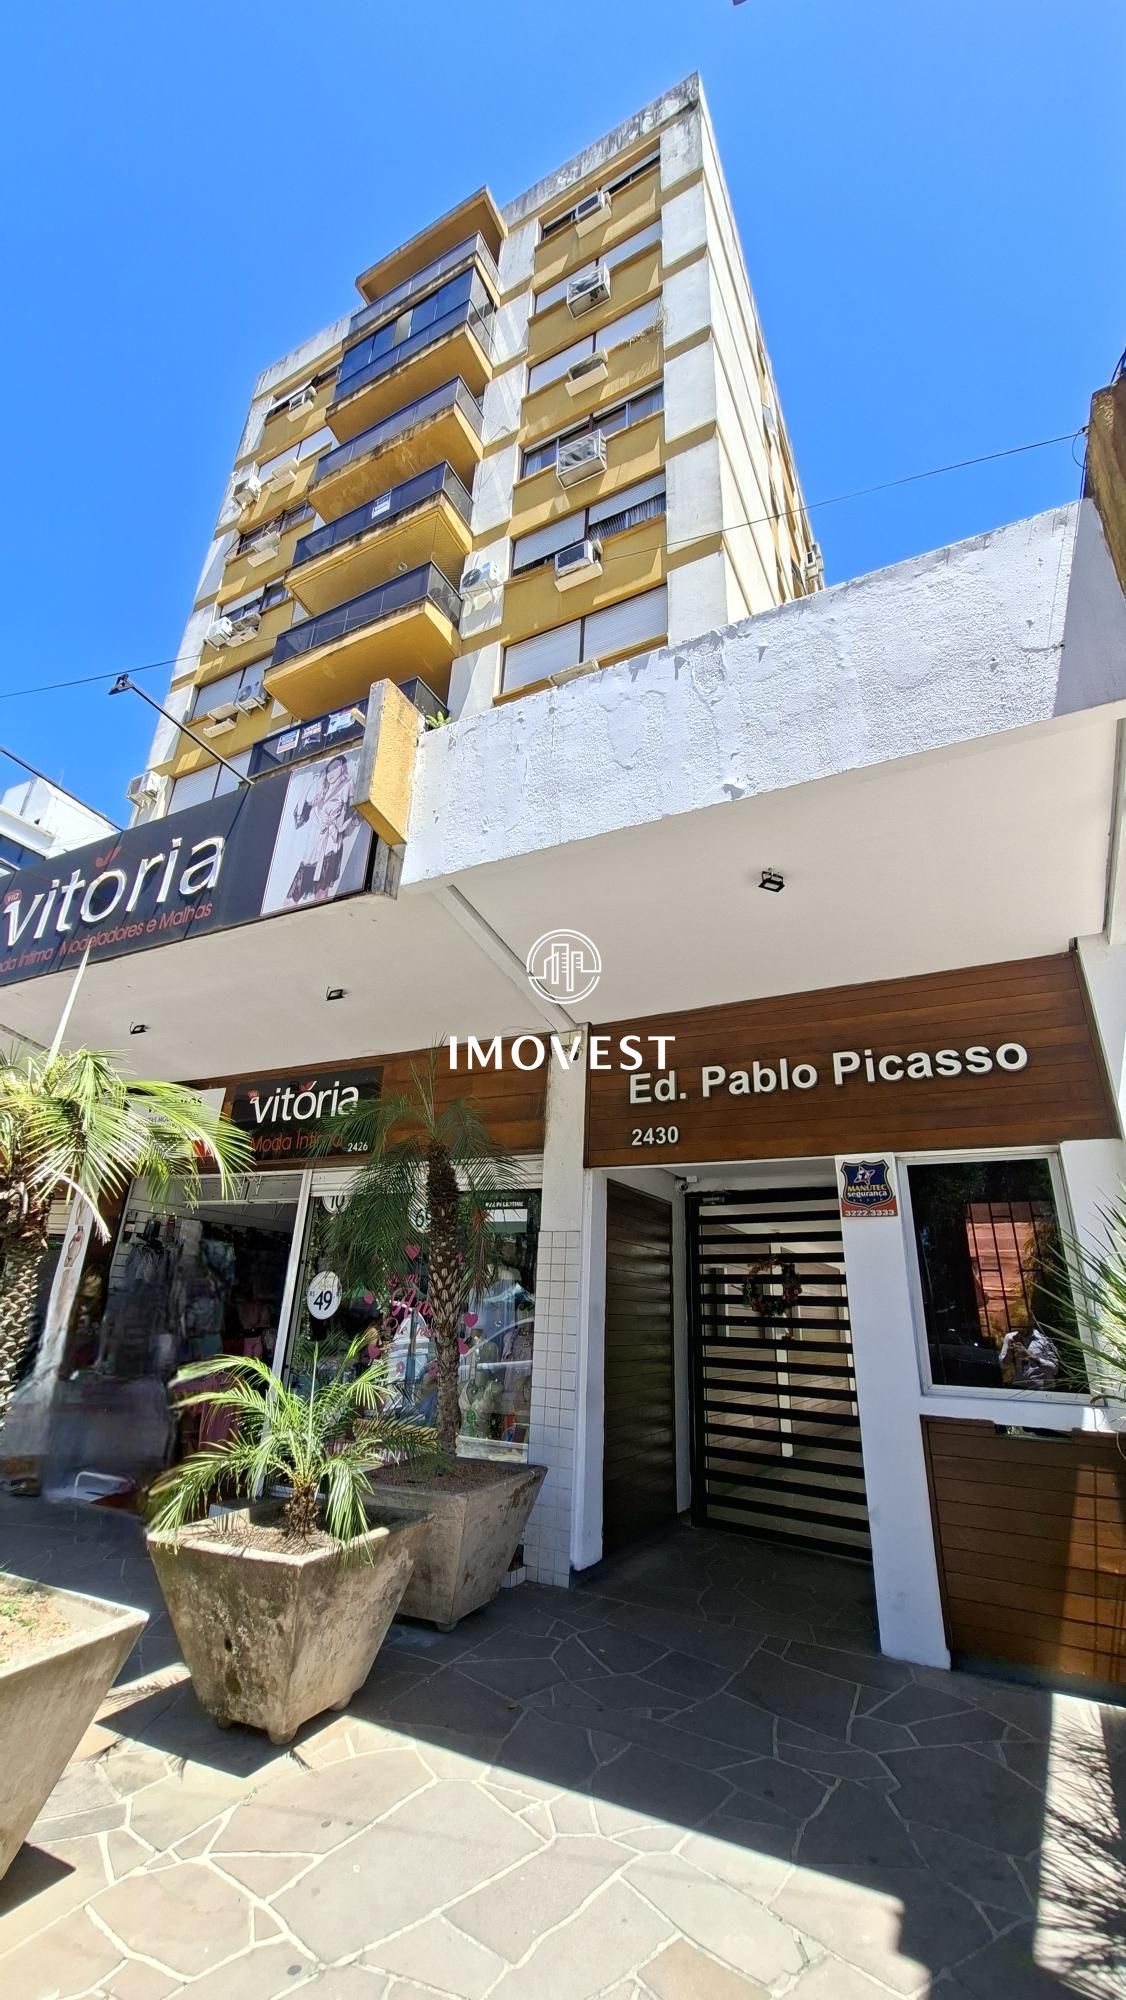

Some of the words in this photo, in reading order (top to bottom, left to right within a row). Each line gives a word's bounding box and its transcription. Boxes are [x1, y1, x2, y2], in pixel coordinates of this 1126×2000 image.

[146, 919, 157, 933] e
[159, 903, 213, 929] Malhas
[629, 1070, 687, 1104] Ed.
[702, 1058, 818, 1098] Pablo
[832, 1043, 1028, 1086] Picasso
[250, 1081, 359, 1123] vitória
[631, 1126, 679, 1146] 2430
[347, 1141, 368, 1152] 2426
[847, 1190, 887, 1198] segurança
[845, 1209, 895, 1217] 3222.3333
[313, 1290, 332, 1310] 49
